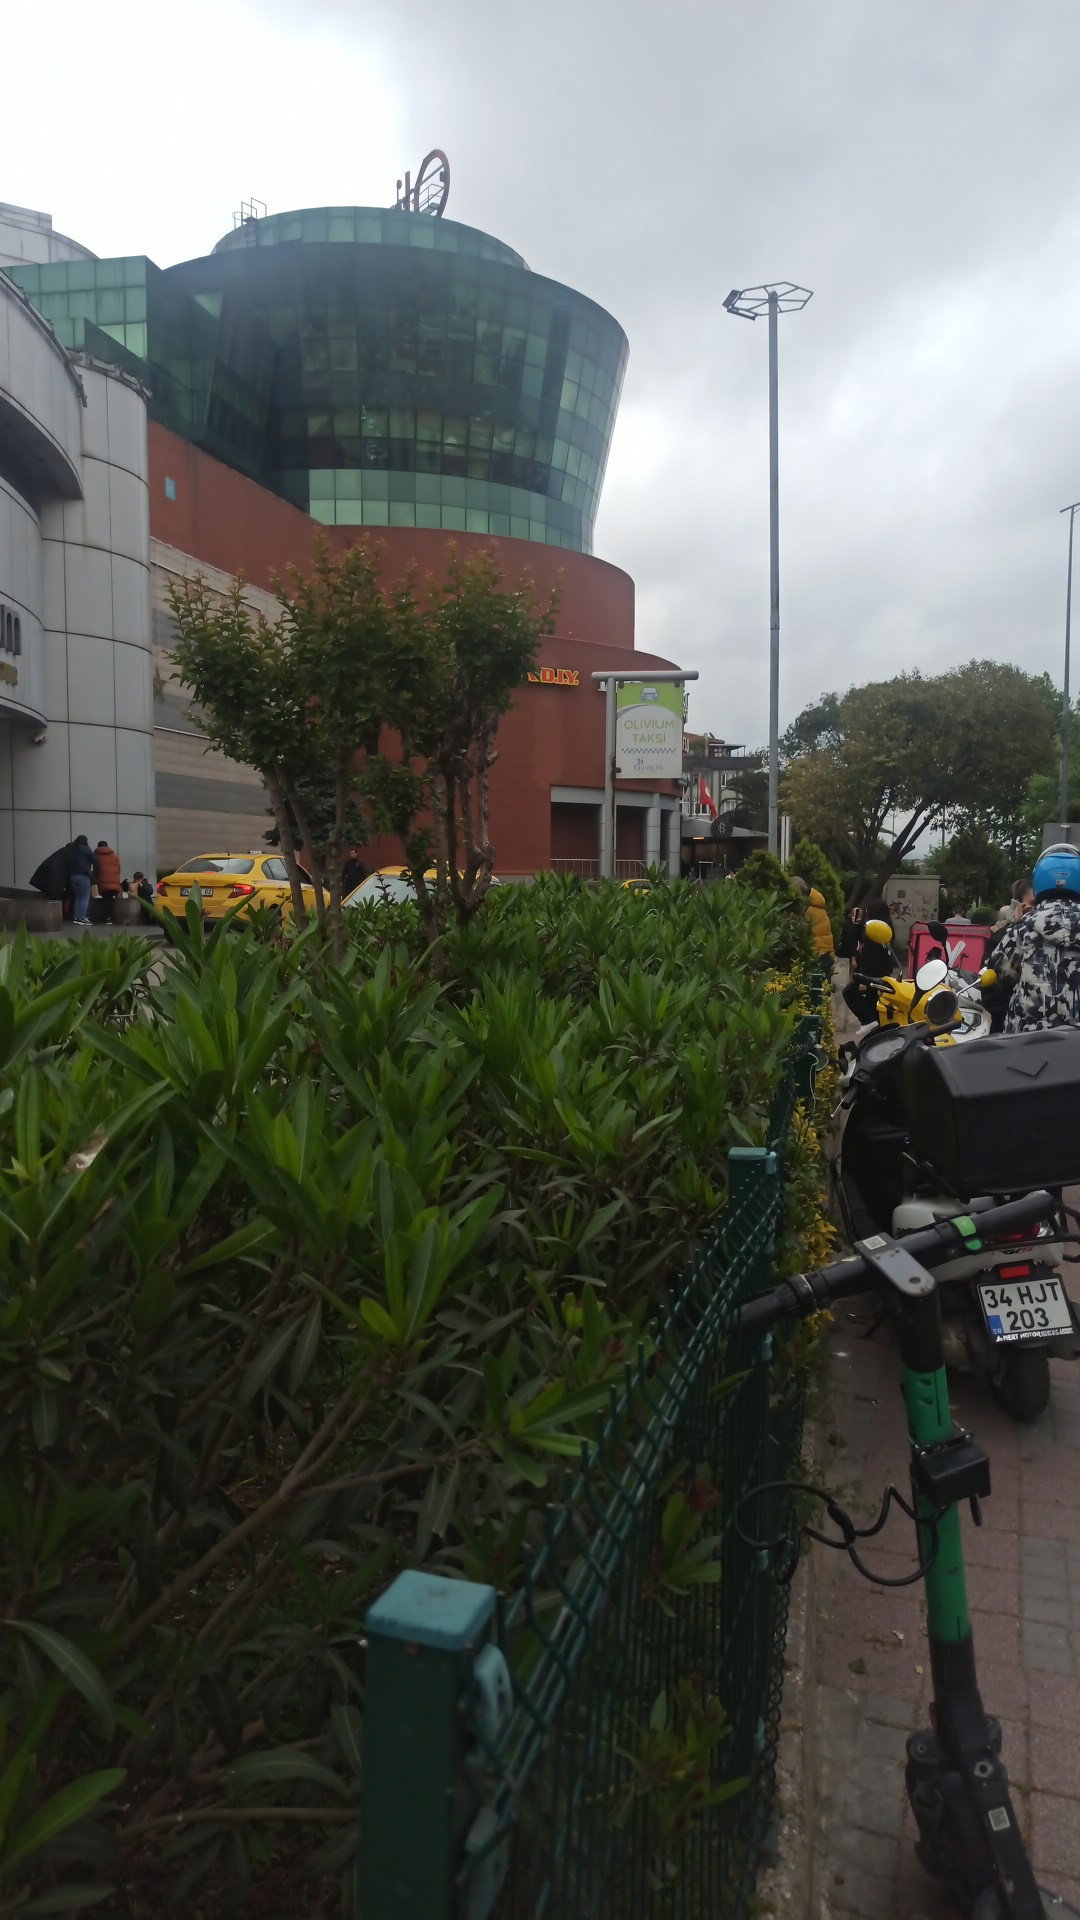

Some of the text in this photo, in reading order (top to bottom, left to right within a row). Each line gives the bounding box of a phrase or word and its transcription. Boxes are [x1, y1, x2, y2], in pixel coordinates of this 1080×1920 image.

[984, 1281, 1059, 1309] 34 HJT
[1006, 1307, 1050, 1331] 203
